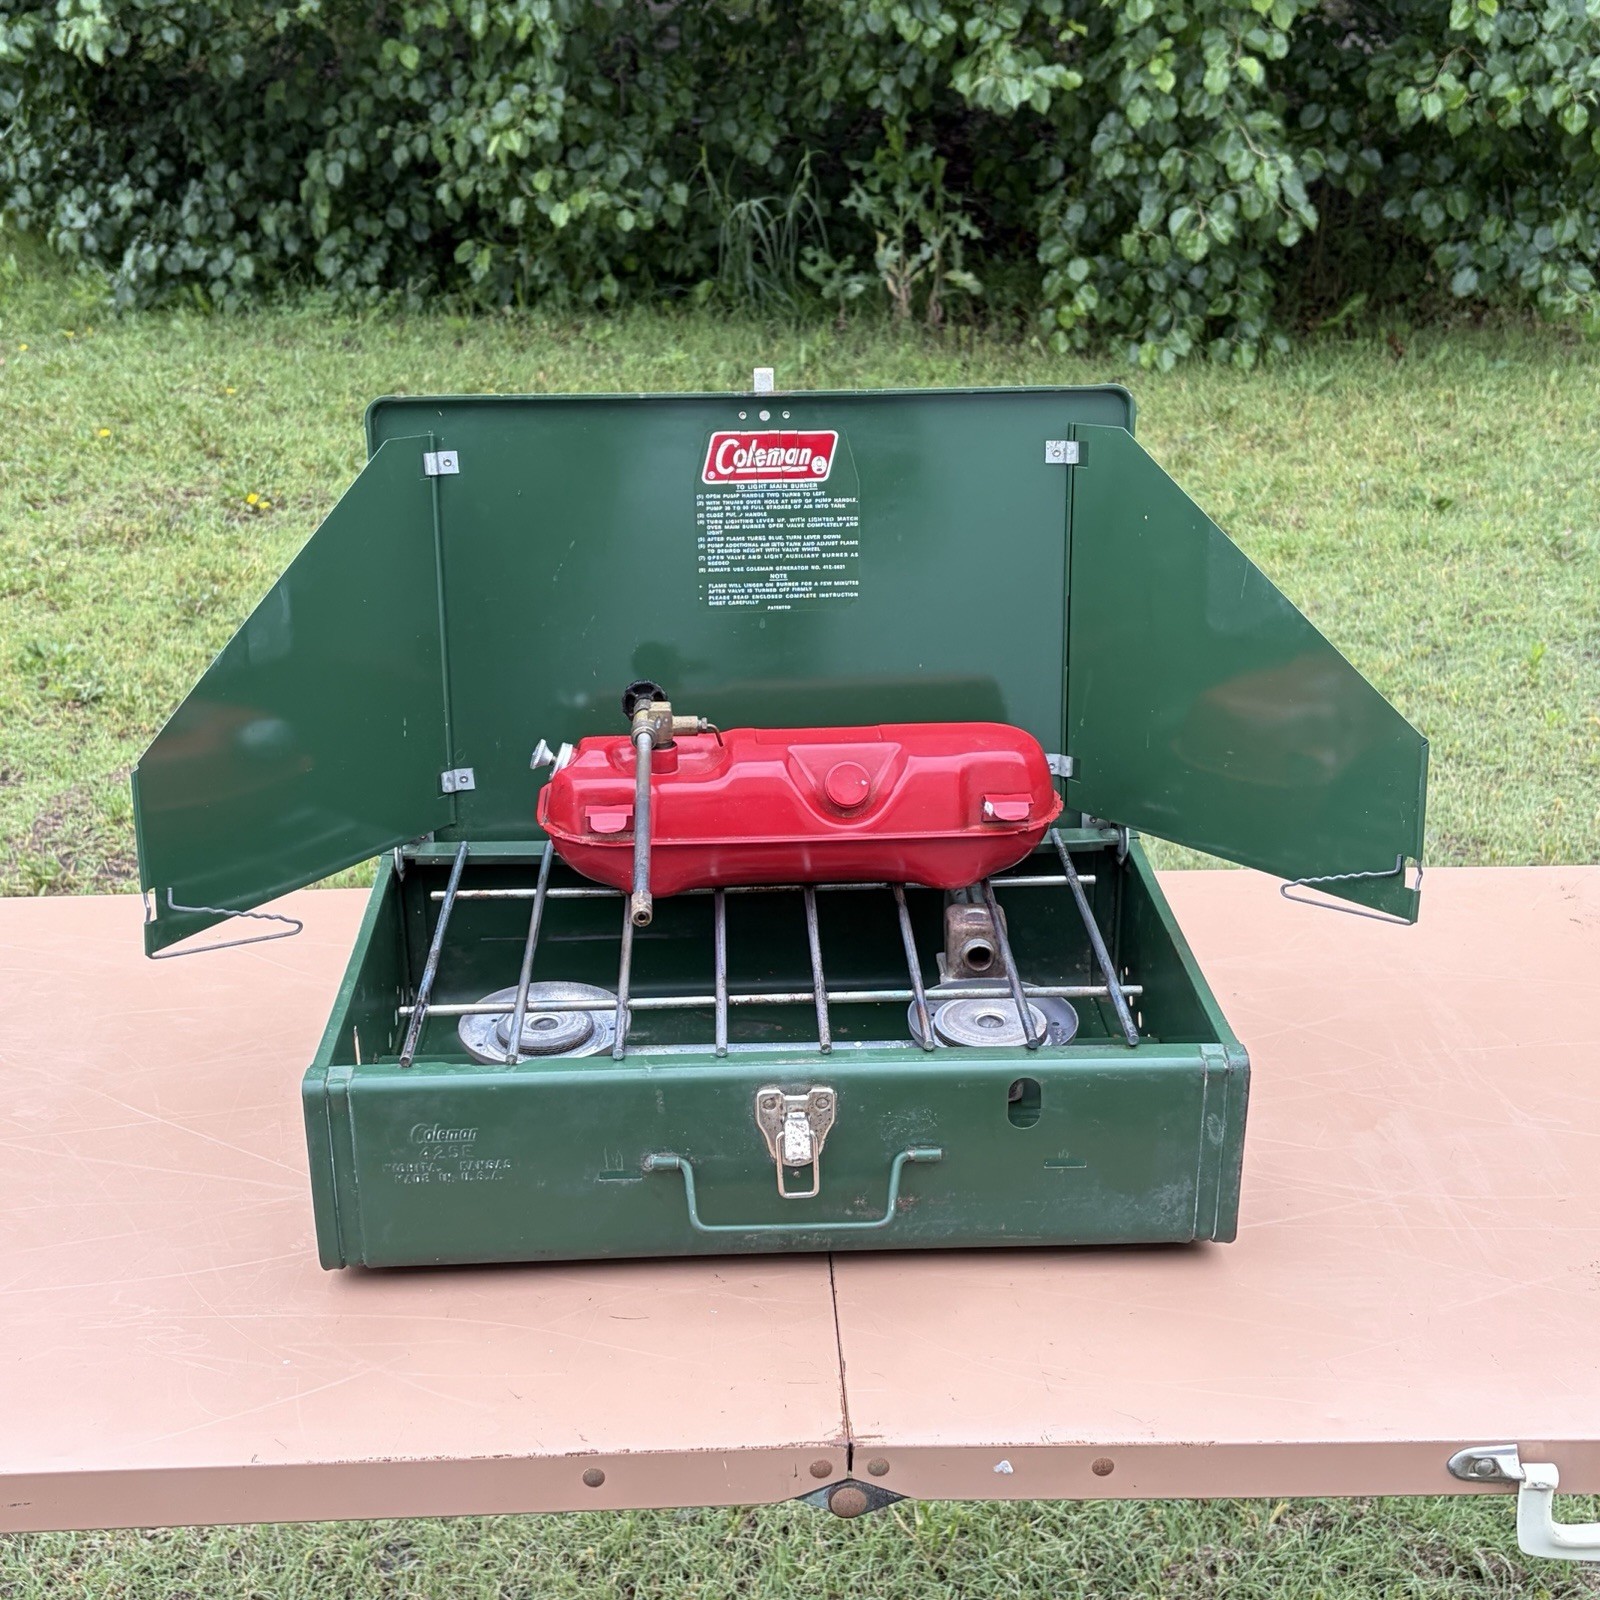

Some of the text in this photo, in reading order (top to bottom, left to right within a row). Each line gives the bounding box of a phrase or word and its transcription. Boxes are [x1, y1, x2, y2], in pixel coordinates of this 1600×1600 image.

[716, 439, 812, 474] Coleman
[411, 1124, 478, 1144] Coleman
[460, 1159, 511, 1171] KANSAS
[395, 1173, 430, 1184] MADE
